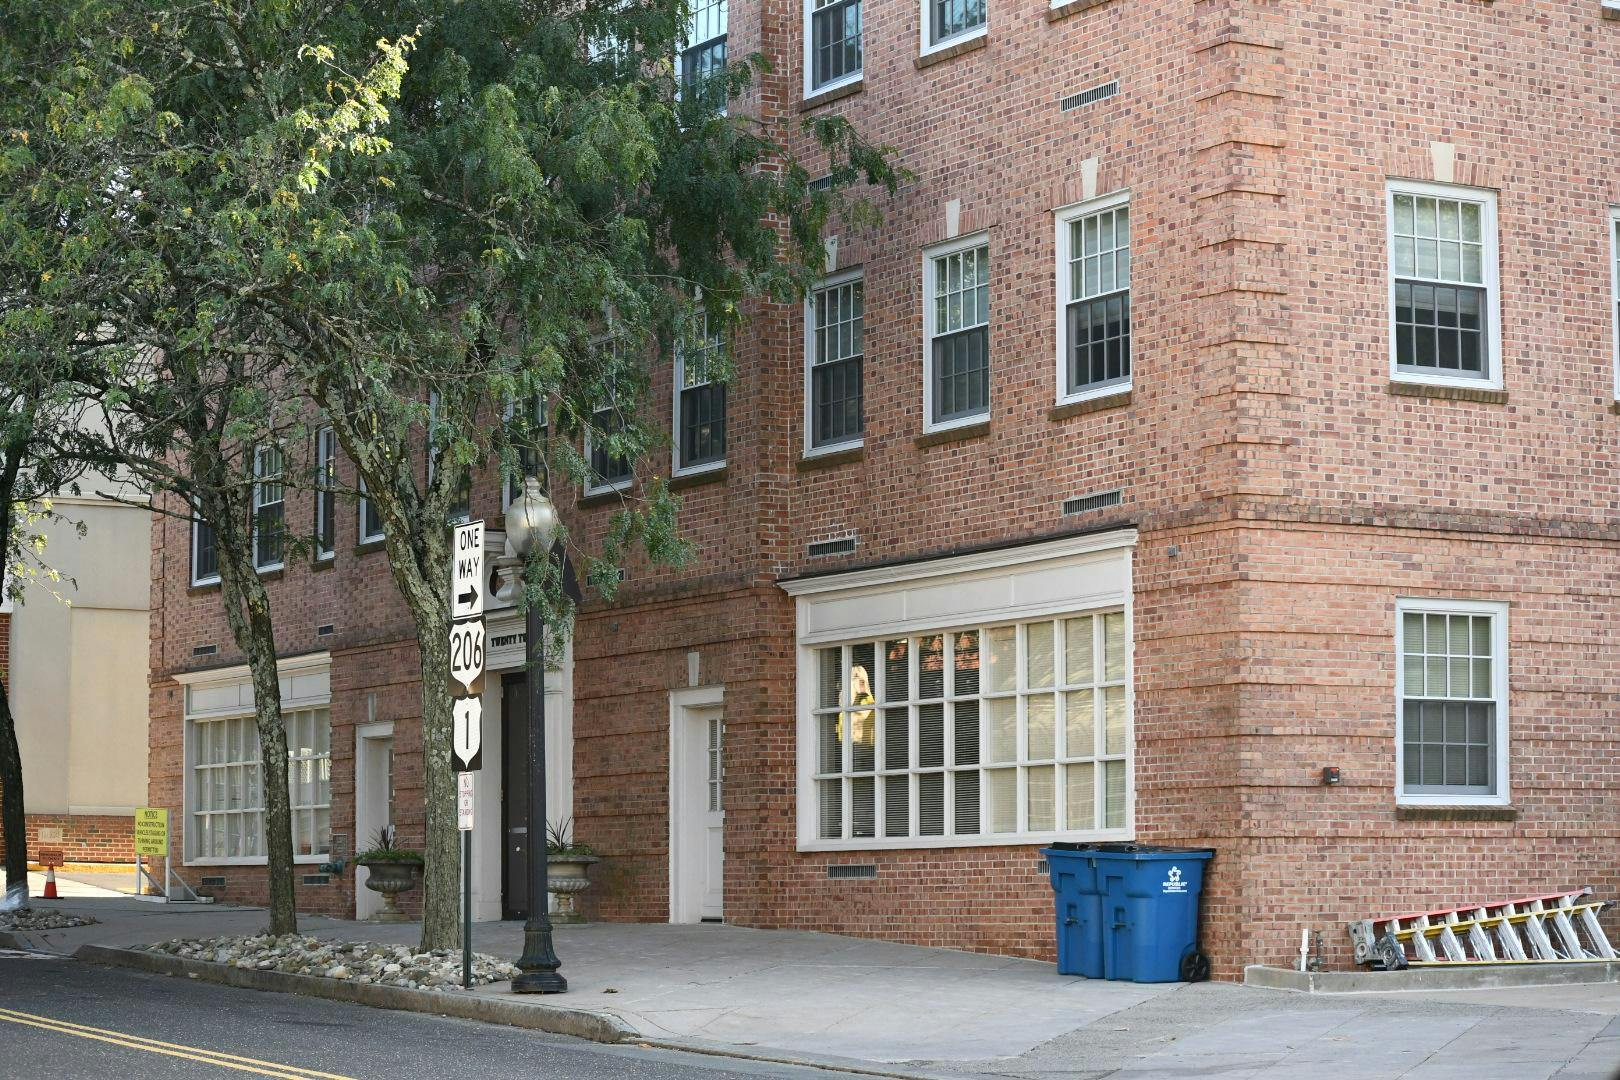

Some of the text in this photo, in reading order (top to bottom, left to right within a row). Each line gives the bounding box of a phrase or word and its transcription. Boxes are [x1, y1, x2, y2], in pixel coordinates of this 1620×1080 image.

[460, 527, 480, 551] ONE
[458, 556, 480, 580] WAY
[452, 630, 482, 671] 206
[491, 635, 516, 647] TWENTY
[464, 710, 470, 750] 1
[144, 810, 158, 819] NOTICE
